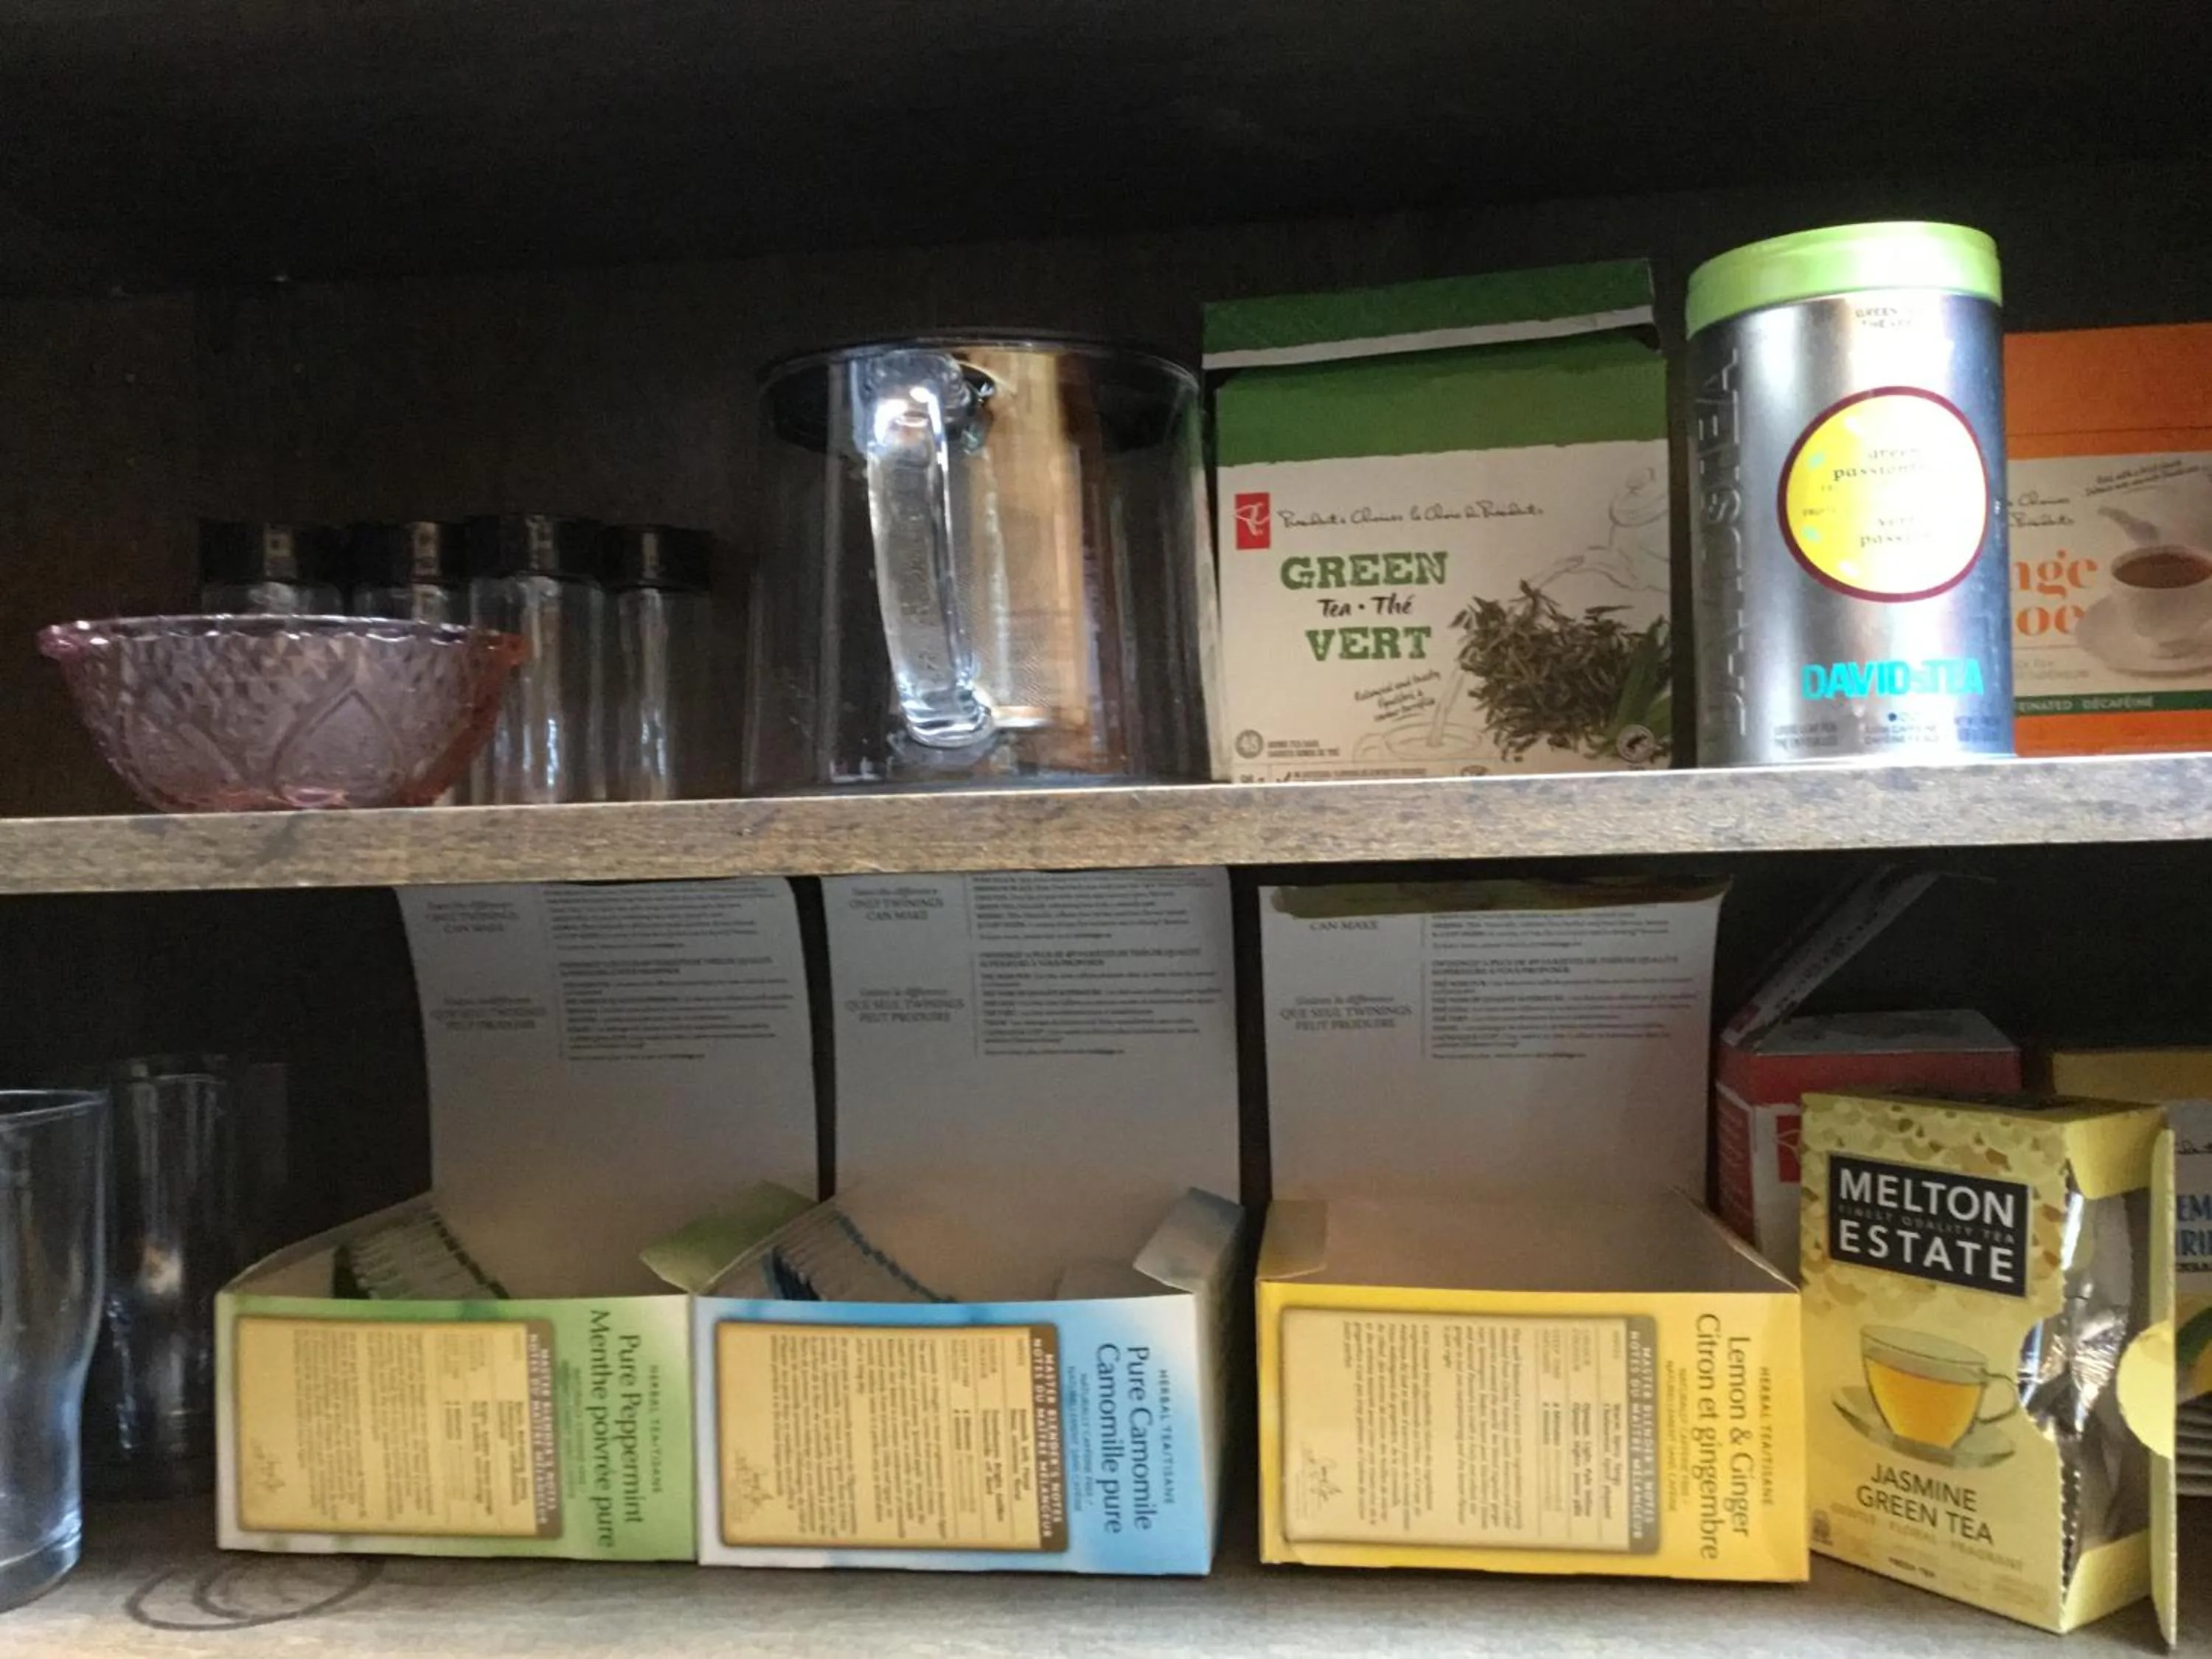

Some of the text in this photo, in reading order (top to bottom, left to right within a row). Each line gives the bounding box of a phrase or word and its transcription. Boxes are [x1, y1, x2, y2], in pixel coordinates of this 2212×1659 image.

[1281, 551, 1448, 591] GREEN
[2014, 549, 2098, 599] nge
[1318, 592, 1414, 618] Tea Thé
[1304, 626, 1432, 661] VERT
[1840, 1169, 2013, 1228] MELTON
[1840, 1219, 2014, 1283] ESTATE
[1046, 1354, 1057, 1403] MASTER
[1158, 1369, 1172, 1420] HERBAL
[585, 1310, 616, 1548] Menthe poivrée pure
[613, 1335, 646, 1523] Pure Peppermint
[1096, 1343, 1125, 1534] Camomille pure
[1127, 1346, 1158, 1531] Pure Camomile
[1691, 1313, 1725, 1560] Citron et gingembre
[1723, 1335, 1756, 1538] Lemon & Ginger
[1051, 1483, 1062, 1523] NOTES
[1856, 1485, 1938, 1528] GREEN
[1946, 1510, 1994, 1546] TEA
[1870, 1463, 1977, 1512] JASMINE
